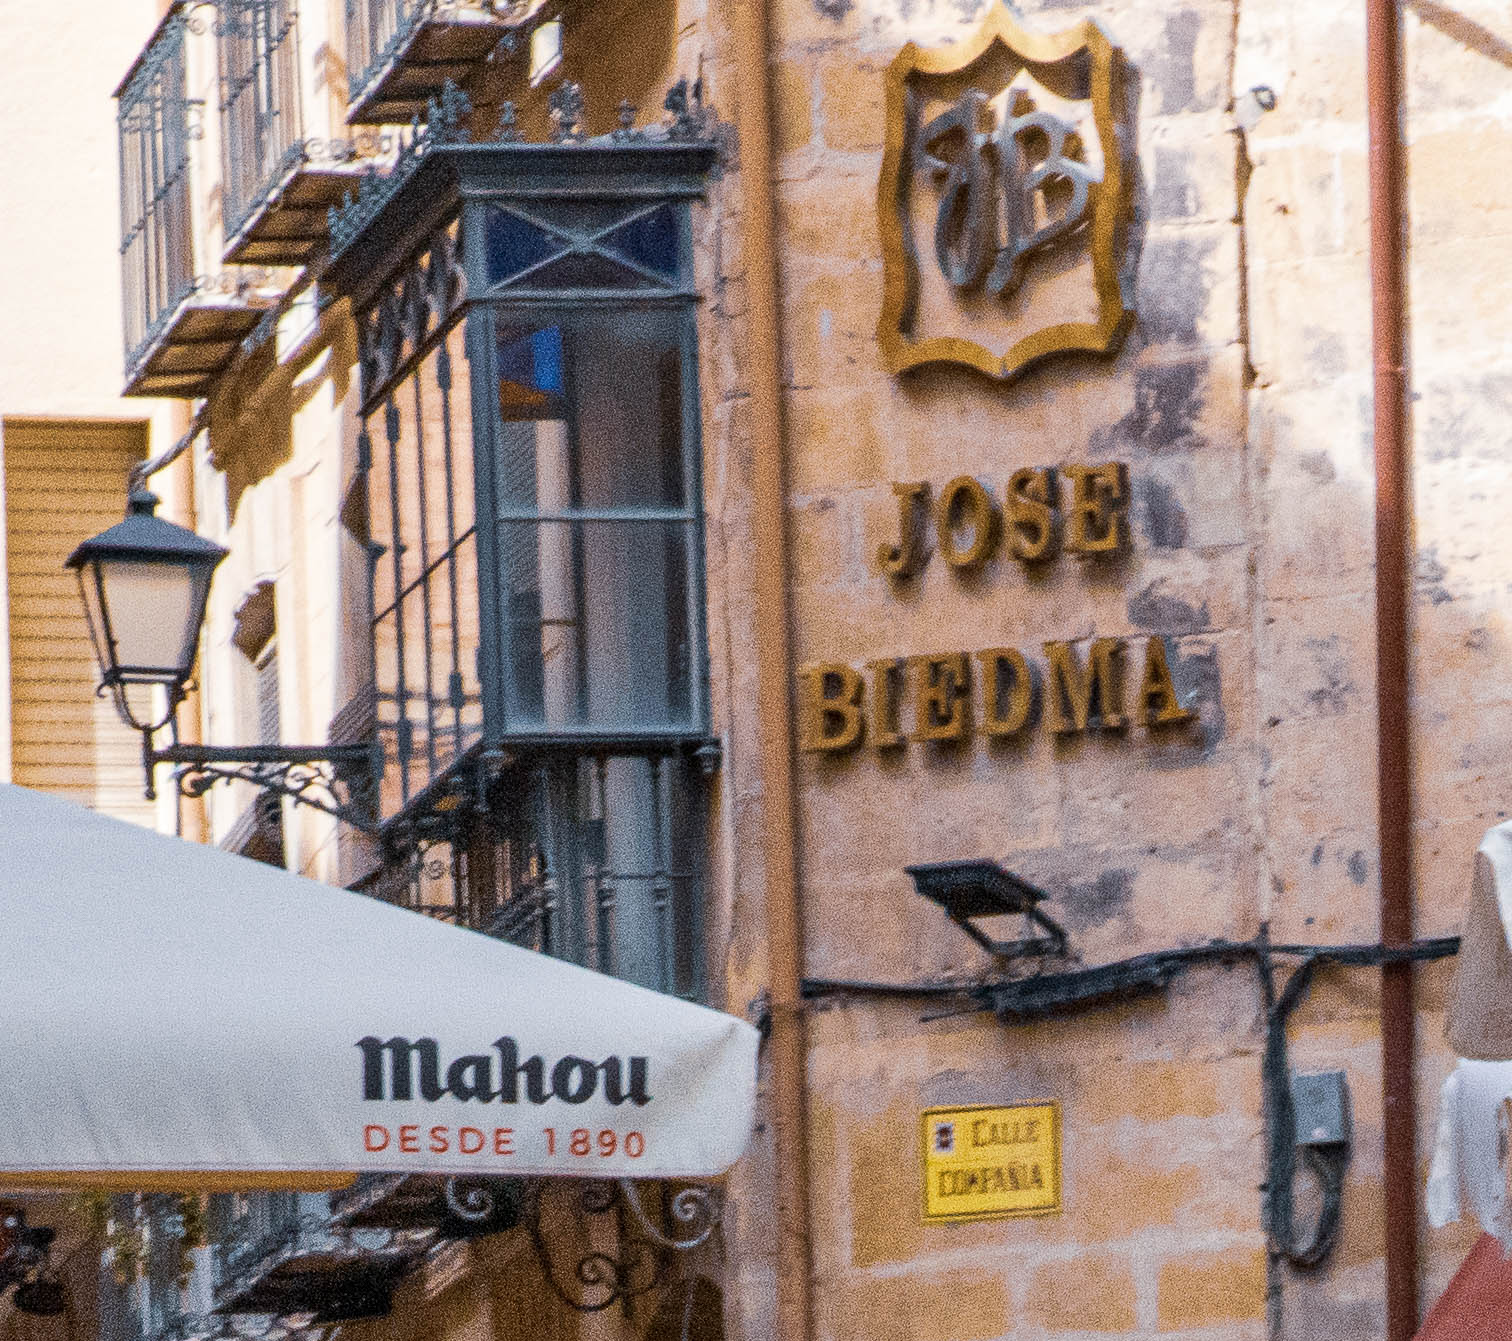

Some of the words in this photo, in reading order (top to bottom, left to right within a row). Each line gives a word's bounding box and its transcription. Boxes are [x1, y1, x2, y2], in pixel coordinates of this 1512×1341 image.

[878, 462, 1130, 577] JOSE
[801, 636, 1197, 755] BIEDMA
[354, 1036, 653, 1106] Mahou
[364, 1124, 514, 1156] DESDE
[544, 1127, 645, 1157] 1890
[972, 1119, 1039, 1147] CALLE
